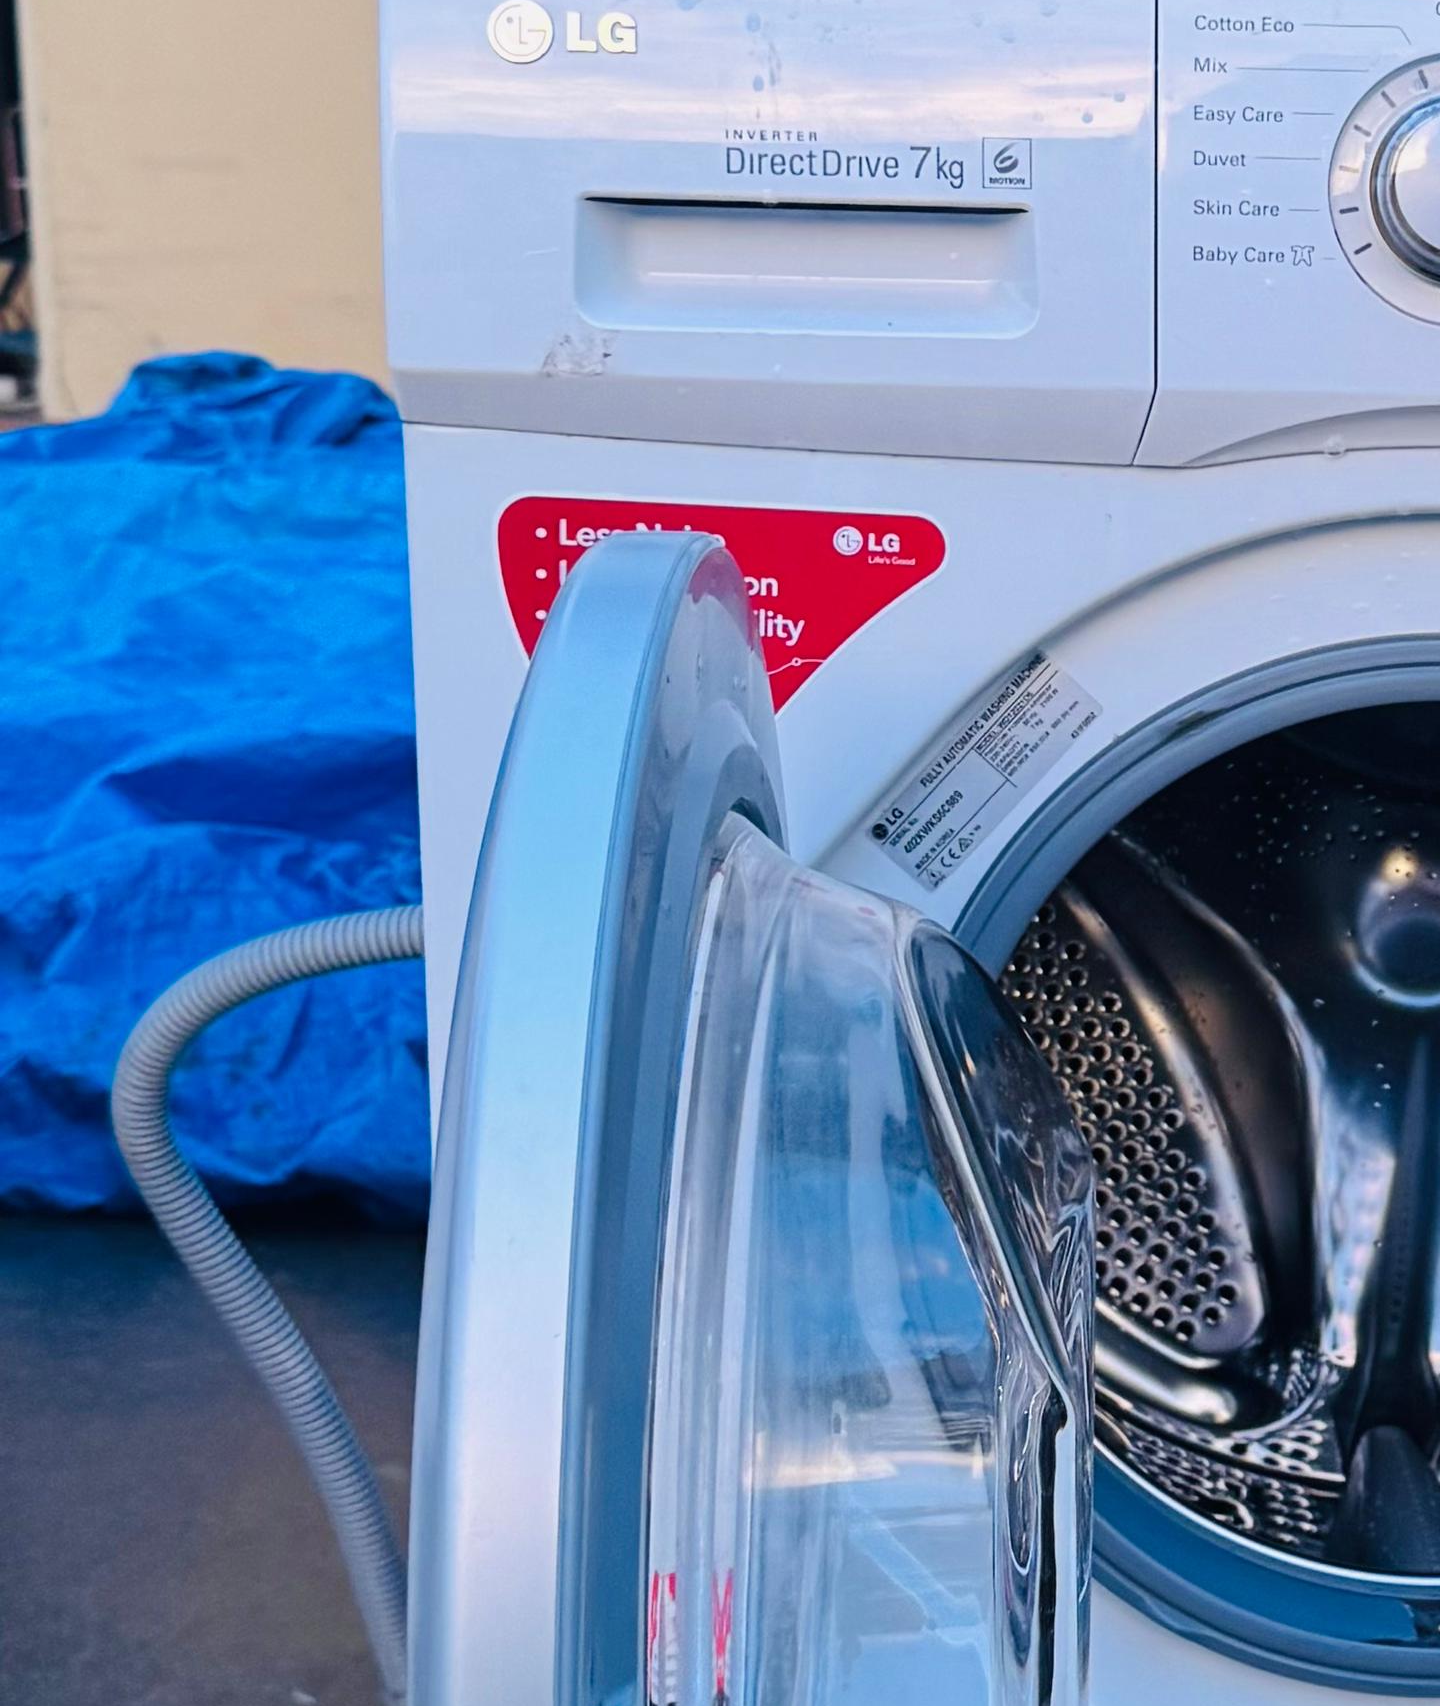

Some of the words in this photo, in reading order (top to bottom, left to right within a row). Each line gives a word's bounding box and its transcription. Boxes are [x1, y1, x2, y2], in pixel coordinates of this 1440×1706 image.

[566, 11, 637, 54] LG
[1194, 15, 1256, 33] Cotton
[1262, 17, 1295, 34] Eco
[1194, 57, 1228, 74] Mix
[1194, 106, 1238, 127] Easy
[1243, 107, 1284, 124] Care
[725, 129, 818, 142] INVERTER
[1193, 151, 1246, 167] Duvet
[1193, 200, 1234, 217] Skin
[1238, 201, 1281, 217] Care
[1192, 246, 1239, 265] Baby
[1244, 248, 1286, 264] Care
[868, 533, 900, 552] LG
[919, 761, 943, 787] FULLY
[942, 720, 983, 764] AUTOMATIC
[979, 686, 1015, 721] WASHING
[884, 807, 903, 825] LG
